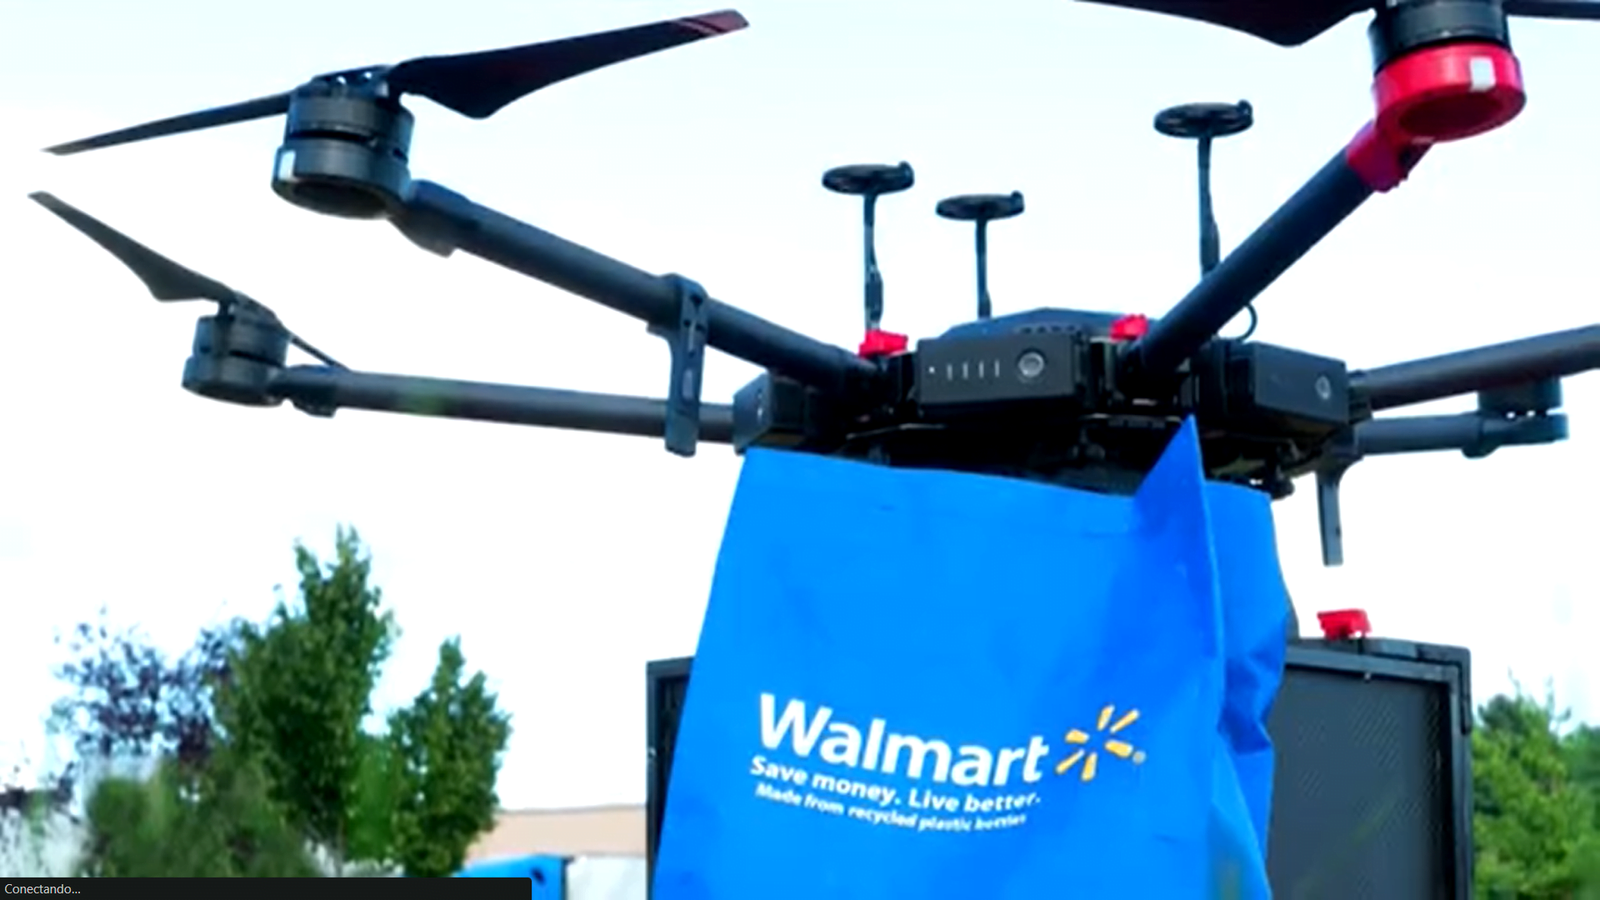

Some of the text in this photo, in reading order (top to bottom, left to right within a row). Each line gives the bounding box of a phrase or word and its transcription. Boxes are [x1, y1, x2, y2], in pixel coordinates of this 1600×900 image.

[759, 692, 1049, 787] Walmart
[749, 755, 1041, 814] Save money. Live better.
[755, 782, 803, 806] Made
[802, 795, 845, 816] from
[848, 805, 918, 828] recycled
[918, 813, 973, 833] plastic
